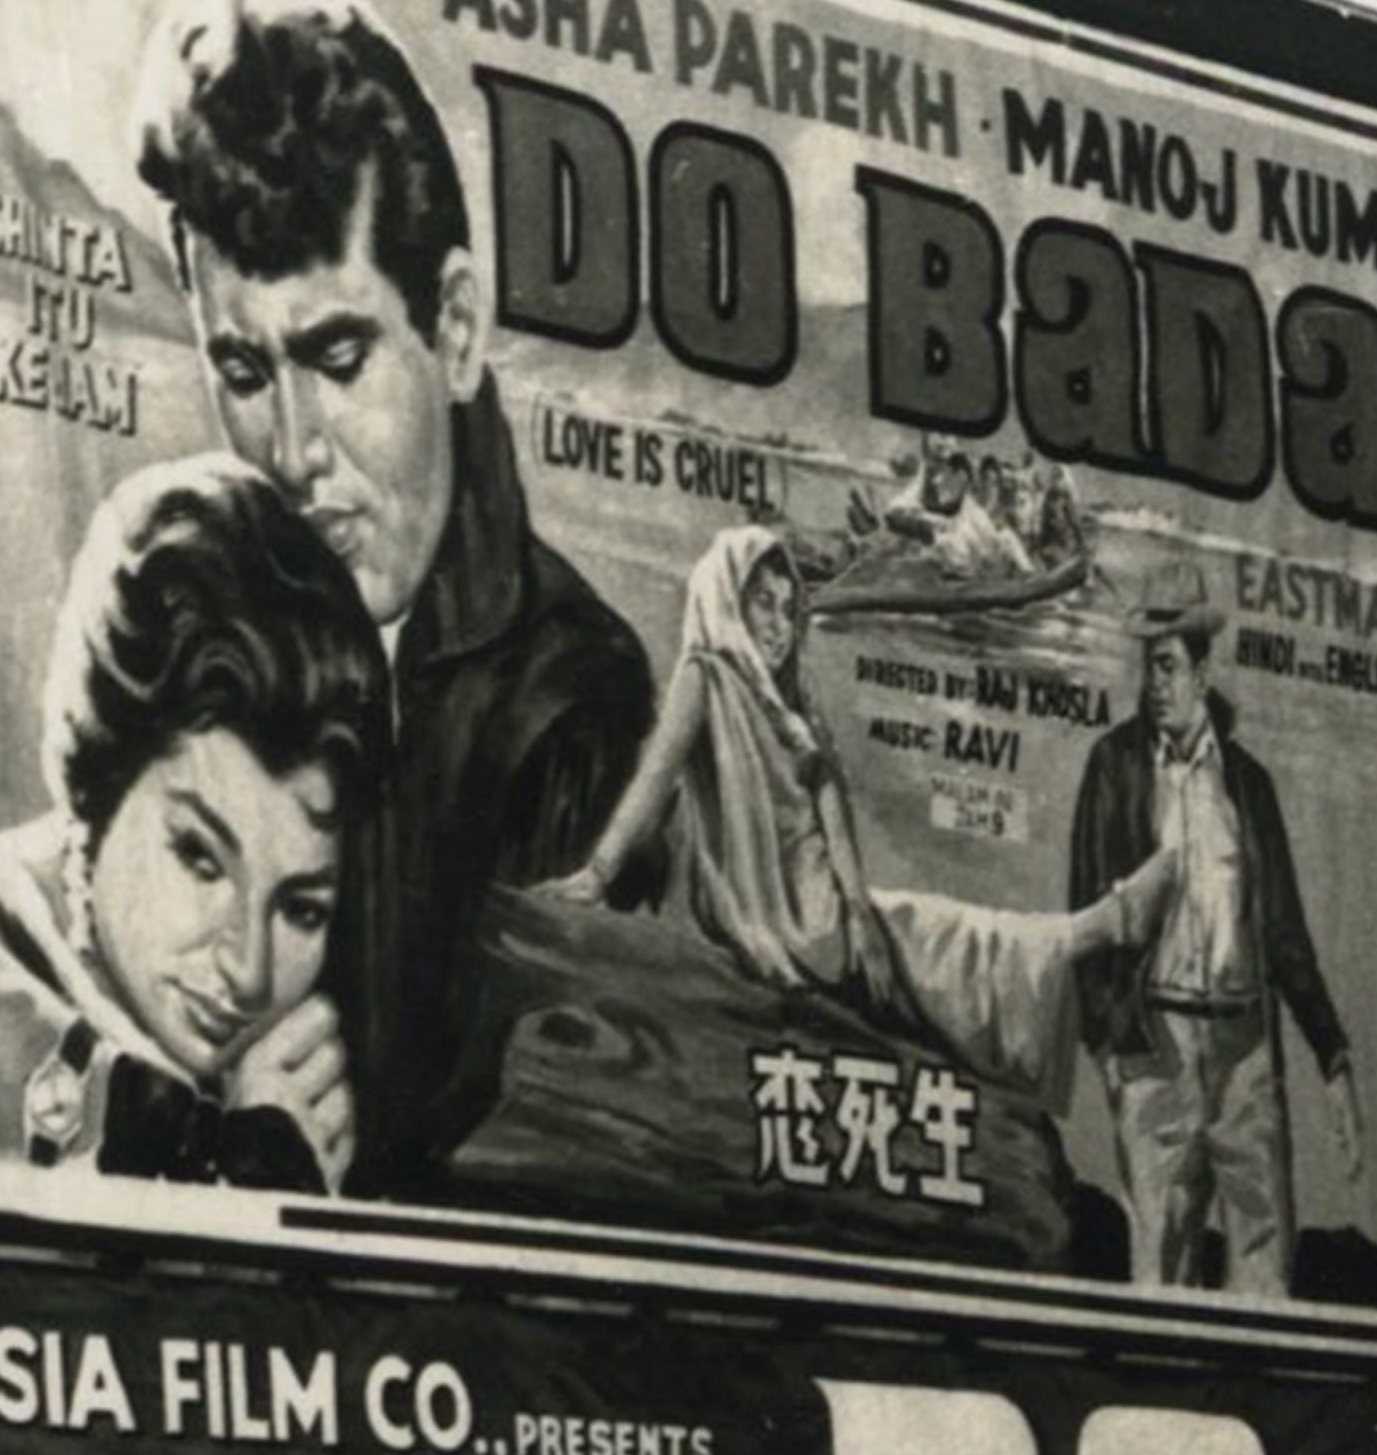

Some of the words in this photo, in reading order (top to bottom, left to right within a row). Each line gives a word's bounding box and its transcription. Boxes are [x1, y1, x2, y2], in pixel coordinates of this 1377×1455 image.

[1002, 87, 1236, 234] MANOJ
[472, 62, 799, 387] DO
[28, 274, 96, 351] ITU
[543, 407, 625, 480] LOVE
[634, 429, 664, 487] IS
[674, 439, 775, 513] CRUEL
[855, 654, 938, 696] DIRECTED
[976, 664, 1019, 713] RAJ
[1027, 674, 1111, 728] KHOSLA
[1235, 626, 1296, 678] HINDI
[943, 718, 1020, 773] RAVI
[160, 1338, 339, 1446] FILM
